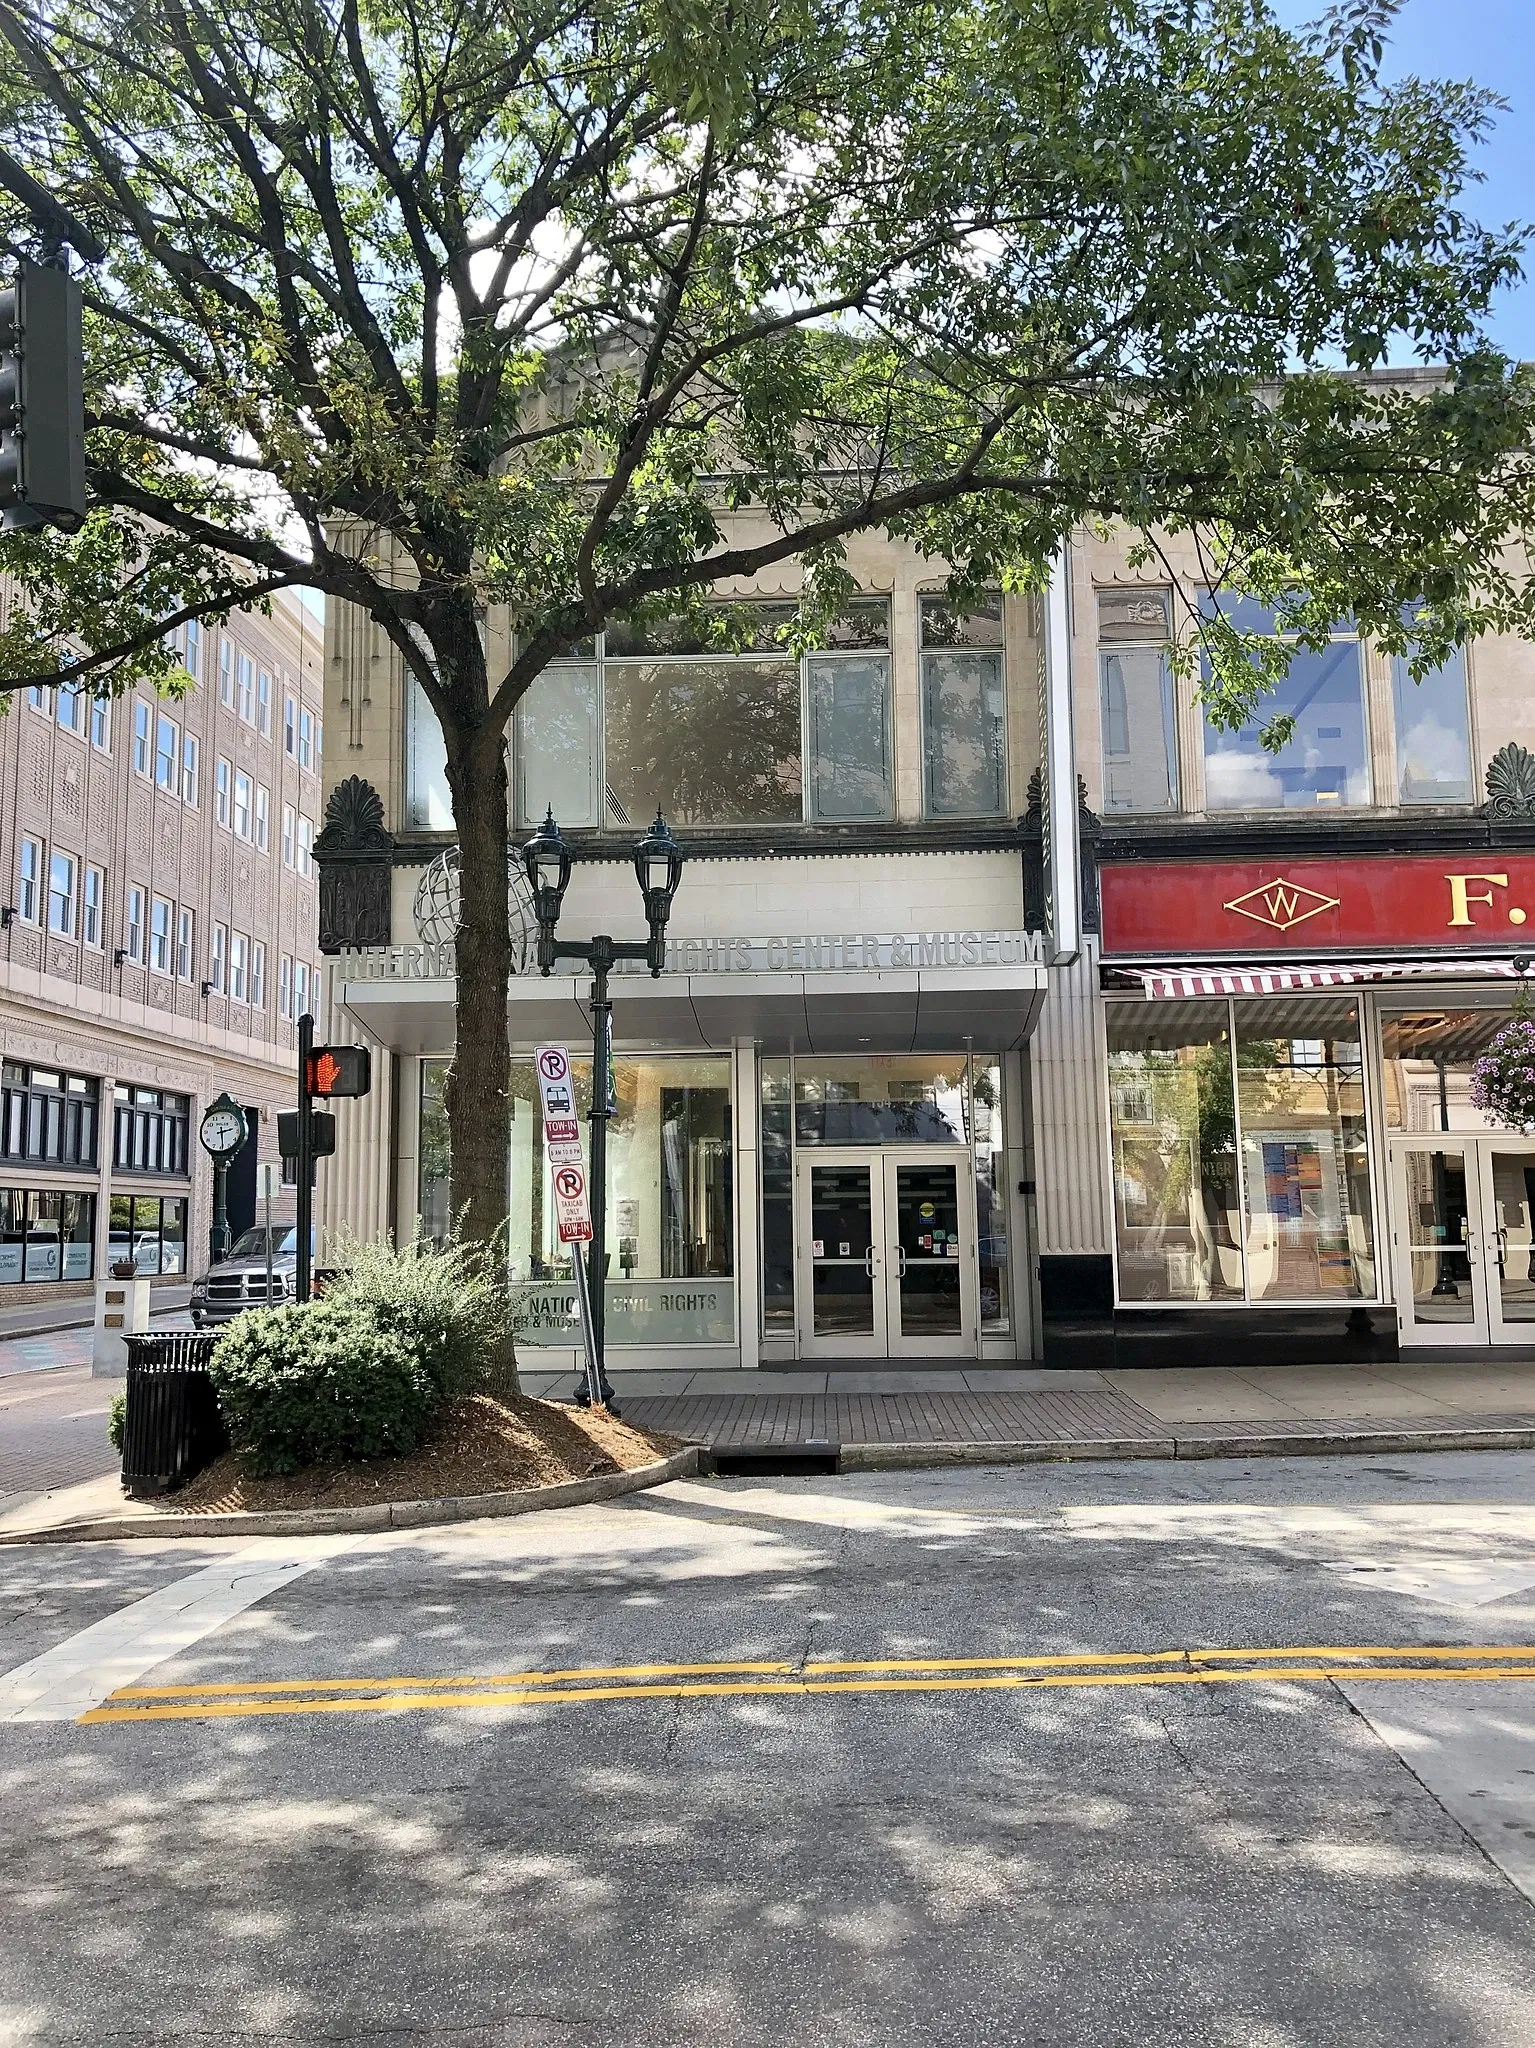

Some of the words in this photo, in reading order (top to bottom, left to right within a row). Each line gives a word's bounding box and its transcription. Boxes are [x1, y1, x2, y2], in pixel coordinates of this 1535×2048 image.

[1263, 886, 1299, 920] W
[1444, 873, 1527, 926] F.
[340, 943, 557, 978] INTERNANA
[664, 938, 752, 972] IGHTS
[767, 935, 880, 970] CENTER
[891, 935, 910, 967] &
[919, 930, 1043, 965] MUSEUM
[547, 1120, 577, 1132] TOW-IN
[561, 1200, 583, 1208] TAXICAB
[566, 1208, 579, 1216] ONLY
[561, 1222, 590, 1236] TOW-IN
[613, 1295, 653, 1312] CIVIL
[659, 1294, 717, 1312] RIGHTS
[546, 1315, 580, 1328] MUSE
